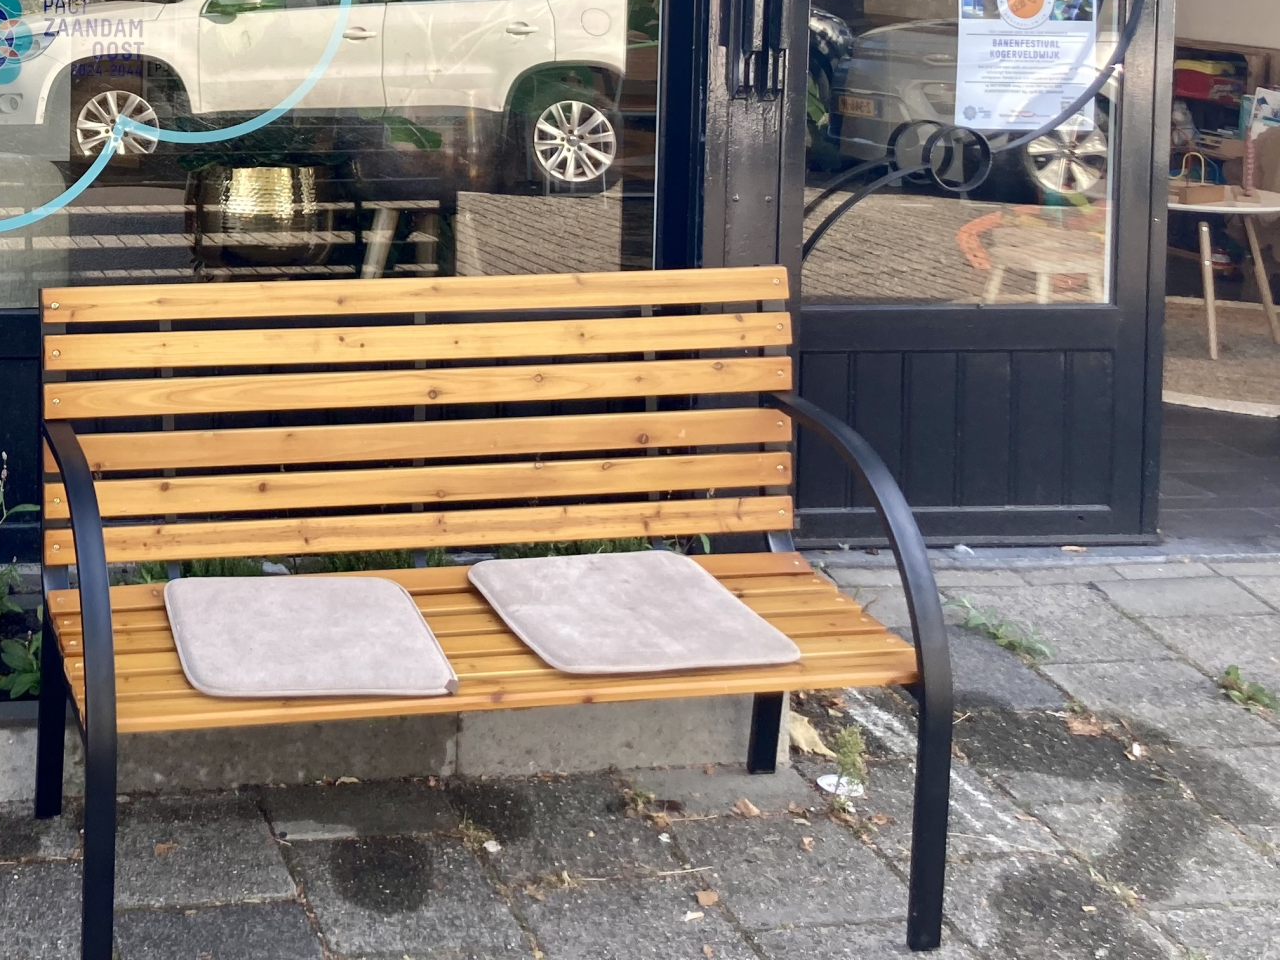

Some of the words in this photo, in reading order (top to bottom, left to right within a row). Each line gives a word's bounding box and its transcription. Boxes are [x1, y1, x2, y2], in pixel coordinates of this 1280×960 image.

[43, 18, 144, 38] ZAANDAM
[992, 38, 1061, 49] BANENFESTIVAL
[92, 41, 145, 62] OOST
[989, 49, 1061, 60] KOGERVELDWIJK
